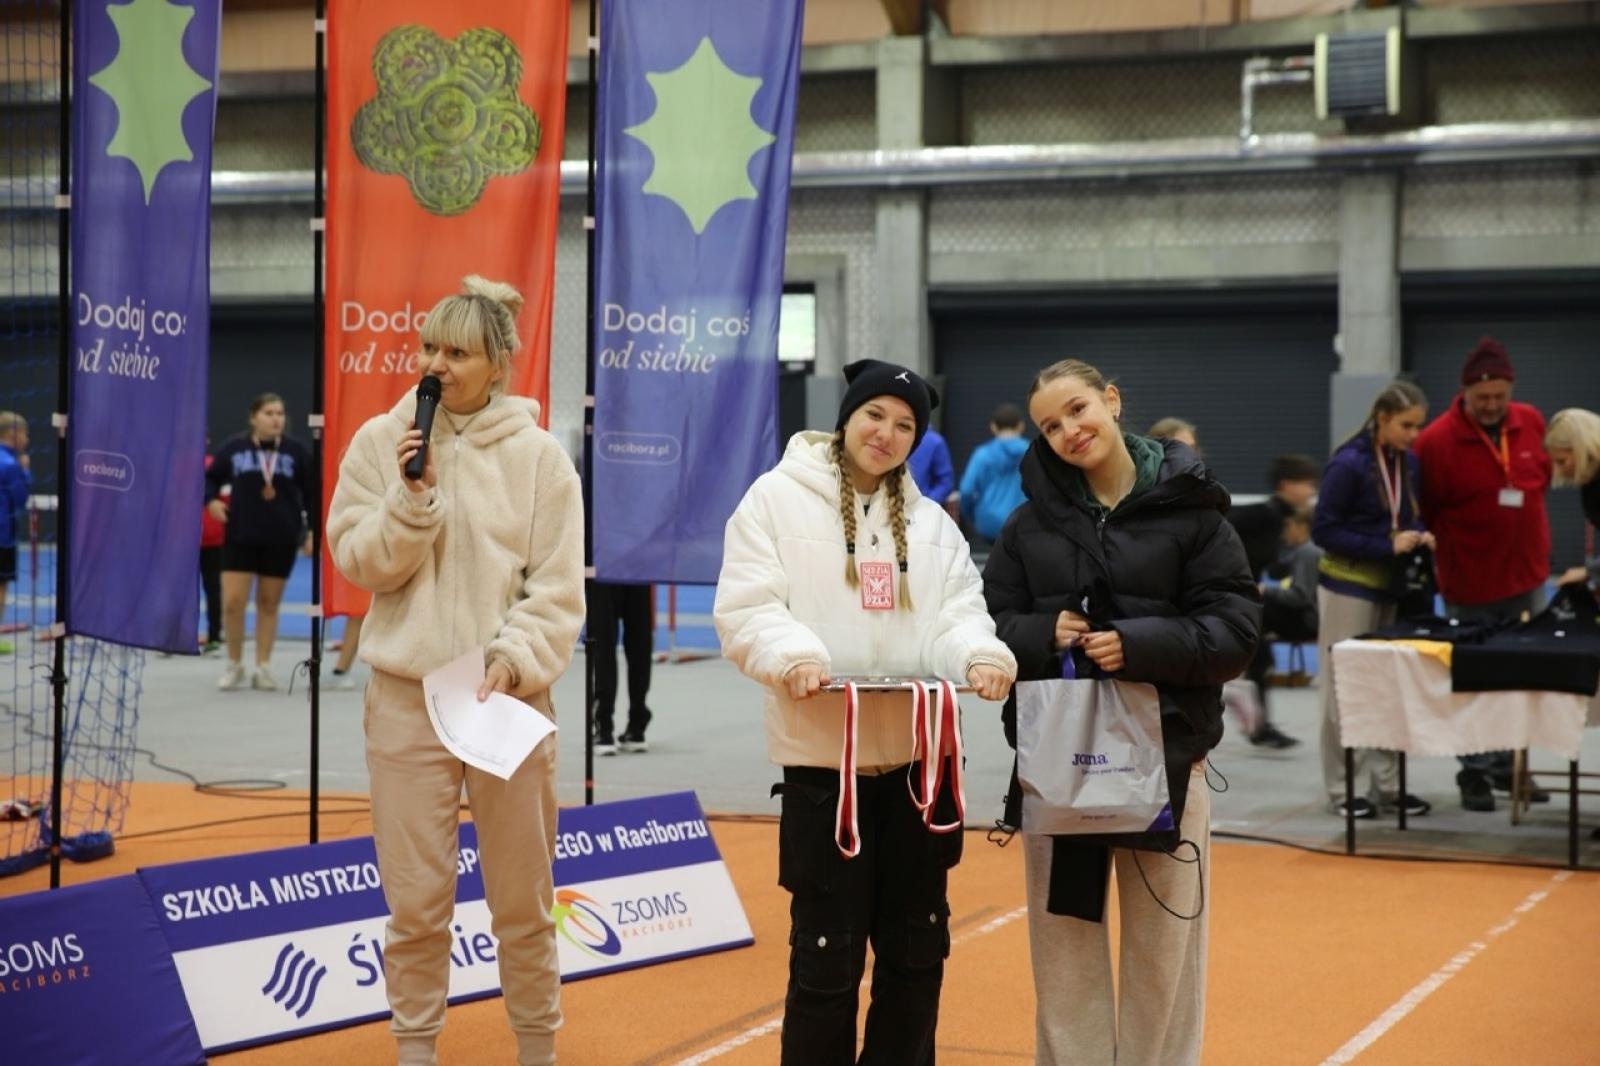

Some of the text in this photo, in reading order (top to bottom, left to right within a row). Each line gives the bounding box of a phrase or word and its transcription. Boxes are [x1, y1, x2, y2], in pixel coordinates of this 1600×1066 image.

[79, 293, 145, 341] Dodaj
[604, 303, 697, 342] Dodaj
[108, 342, 160, 380] siebie
[340, 341, 419, 375] od sie
[600, 341, 716, 373] od siebie
[163, 881, 269, 922] SZKOŁA
[270, 862, 381, 904] MISTRZO
[595, 832, 614, 852] w
[614, 819, 709, 850] Raciborzu
[611, 891, 687, 924] ZSOMS
[0, 933, 84, 976] SOMS
